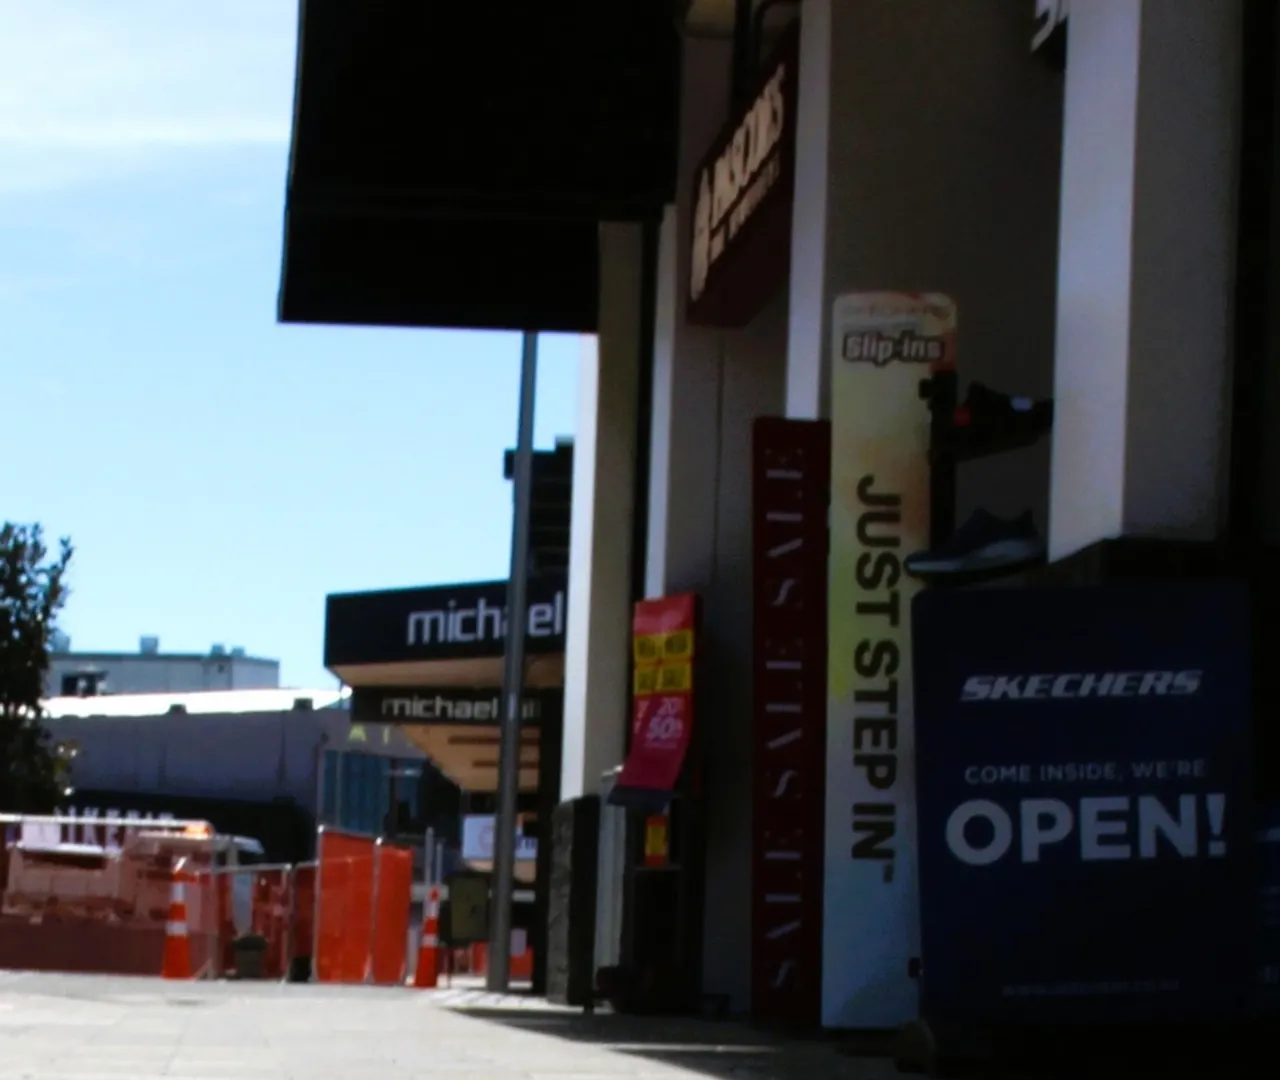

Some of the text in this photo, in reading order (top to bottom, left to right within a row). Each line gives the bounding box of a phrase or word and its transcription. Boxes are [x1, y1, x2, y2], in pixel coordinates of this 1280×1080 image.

[856, 474, 901, 628] JUST
[406, 590, 564, 646] michel
[381, 693, 498, 719] michael
[959, 669, 1204, 702] SKECHERS
[853, 638, 900, 790] STEP
[964, 758, 1206, 785] COME INSIDE, WE'RE
[945, 792, 1227, 866] OPEN!
